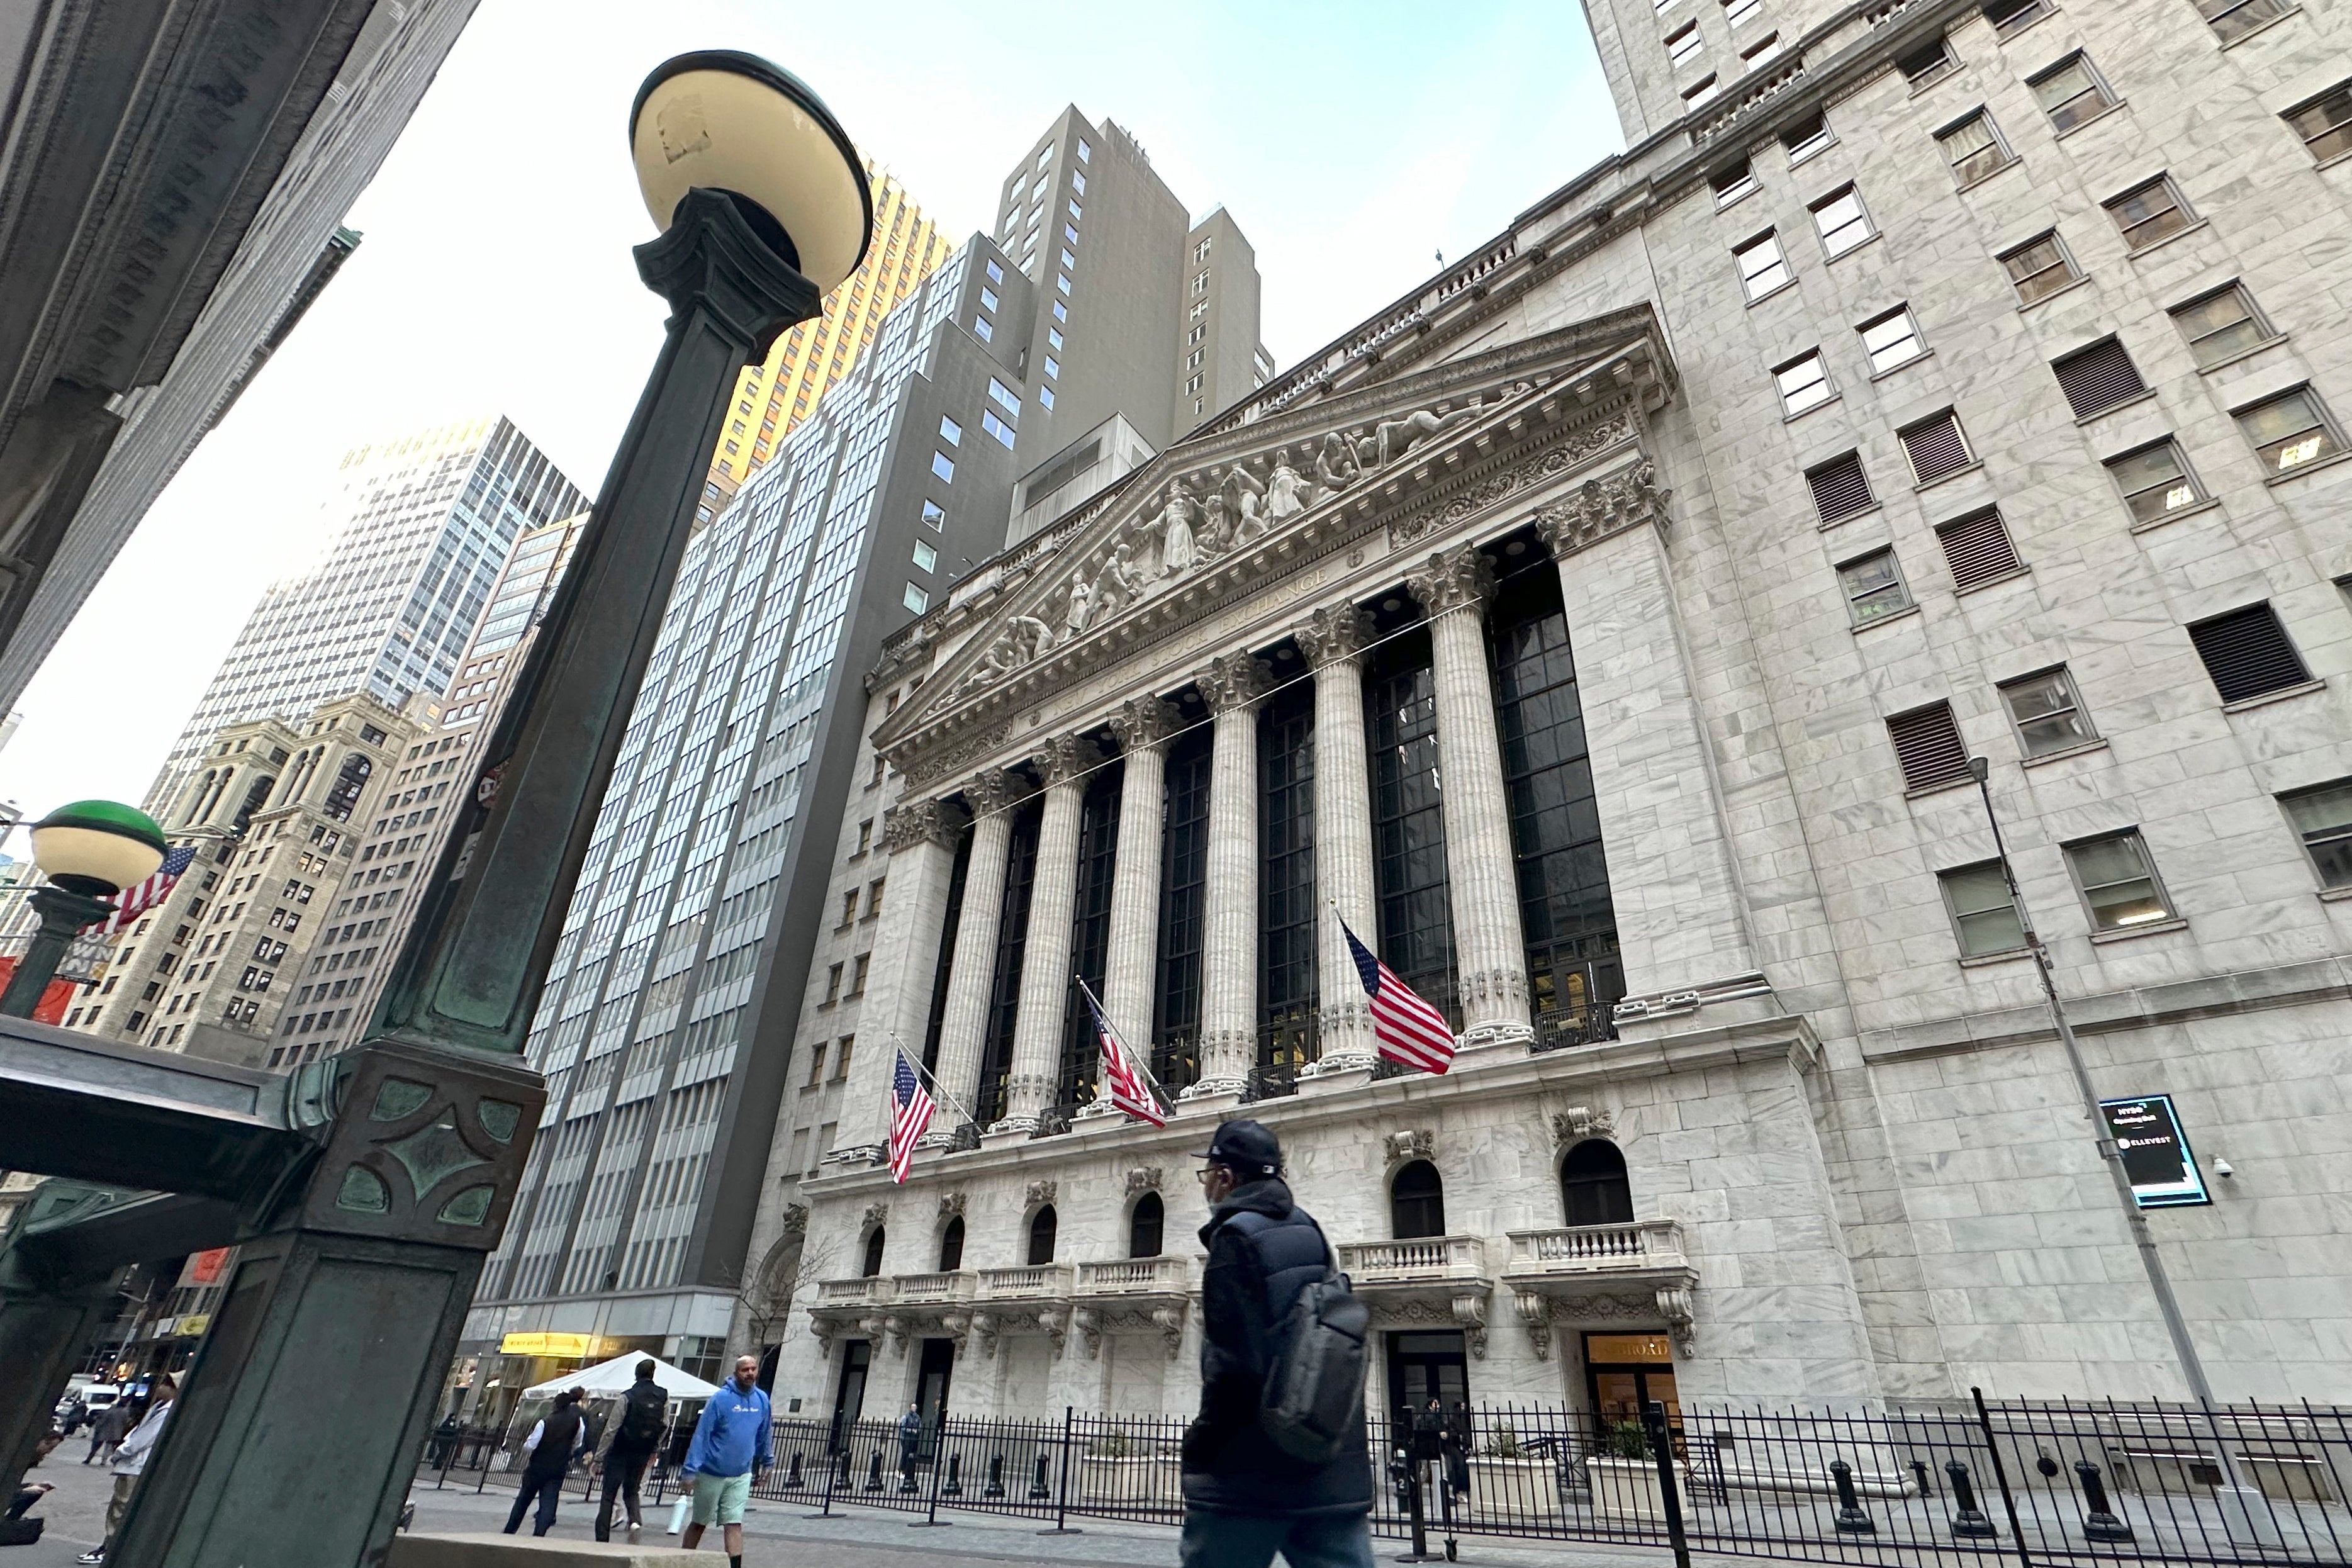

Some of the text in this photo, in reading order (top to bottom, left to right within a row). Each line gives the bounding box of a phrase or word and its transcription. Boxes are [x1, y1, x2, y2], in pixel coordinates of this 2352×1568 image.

[1054, 568, 1328, 715] NEW YORK STOCK EXCHANGE
[2131, 1136, 2171, 1146] ELLEVEST
[1398, 1479, 1404, 1489] 2
